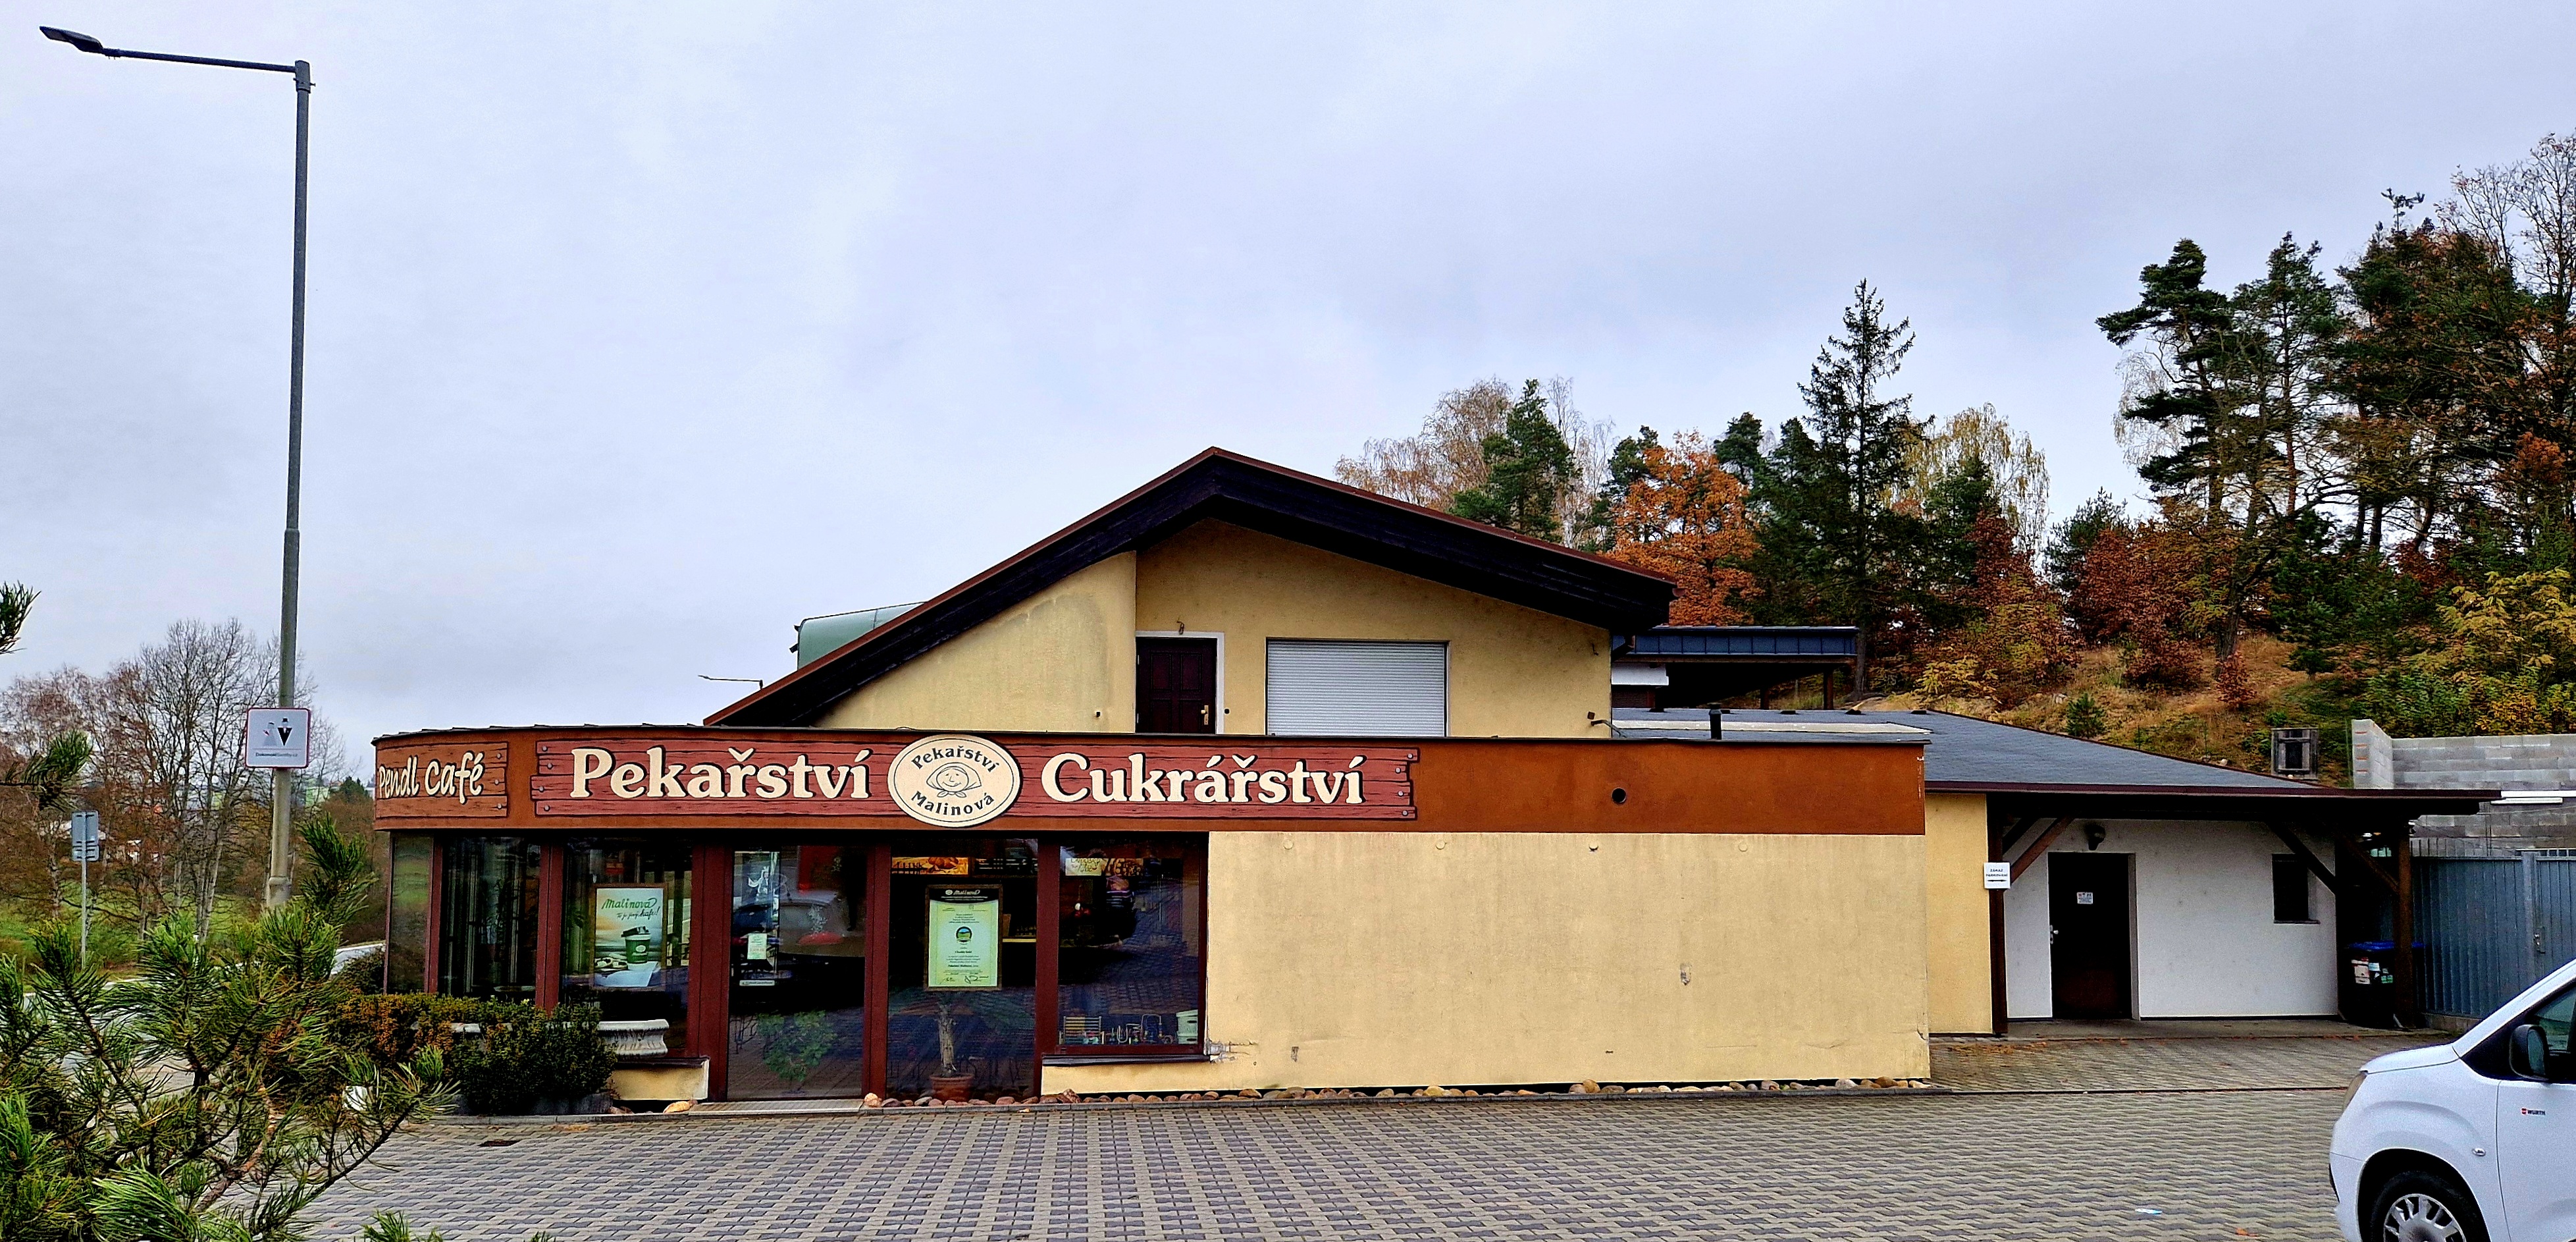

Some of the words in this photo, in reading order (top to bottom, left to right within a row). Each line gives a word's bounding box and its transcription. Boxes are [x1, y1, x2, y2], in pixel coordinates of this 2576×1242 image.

[379, 756, 419, 798] Pendl
[425, 752, 484, 804] Café
[570, 747, 870, 798] Pekařství
[911, 745, 1000, 772] Pekařství
[1041, 752, 1366, 803] Cukrářství
[911, 790, 995, 816] Malinová
